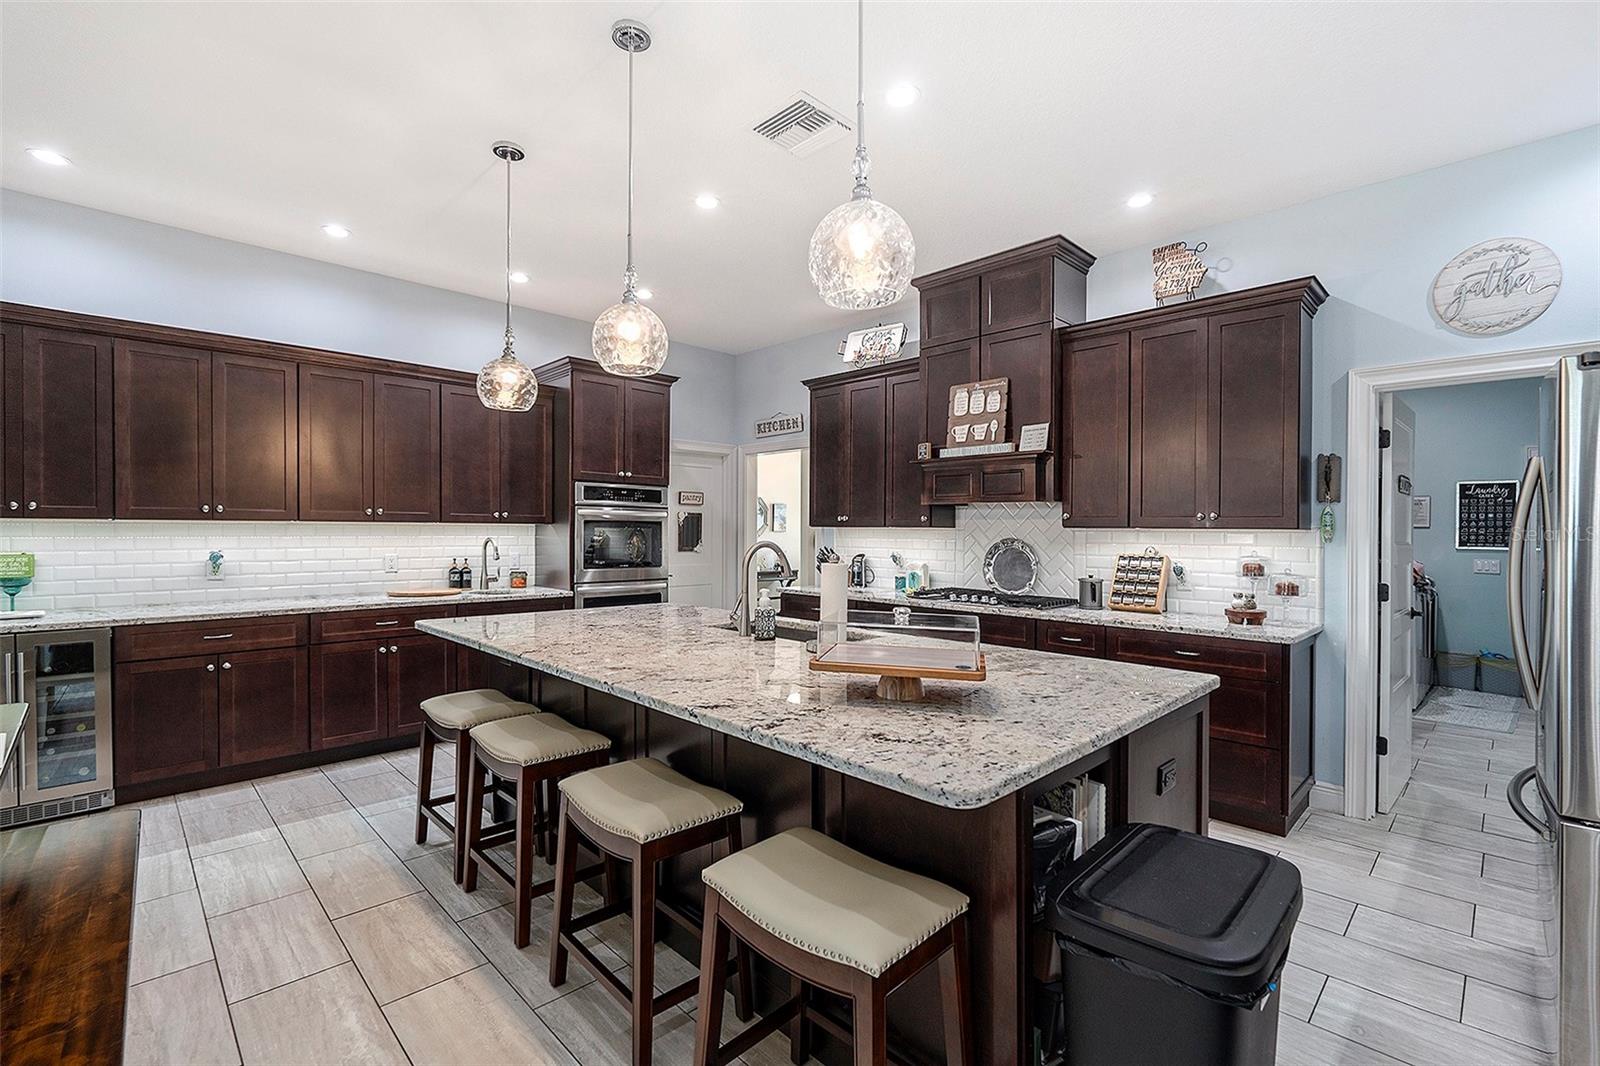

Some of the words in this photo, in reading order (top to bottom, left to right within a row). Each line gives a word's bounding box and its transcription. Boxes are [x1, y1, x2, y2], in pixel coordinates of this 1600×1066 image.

[1153, 257, 1206, 284] Georgia
[1163, 277, 1186, 290] 1732
[1443, 253, 1559, 324] gather
[756, 417, 799, 435] KITCHEN
[1465, 484, 1510, 498] Laundry
